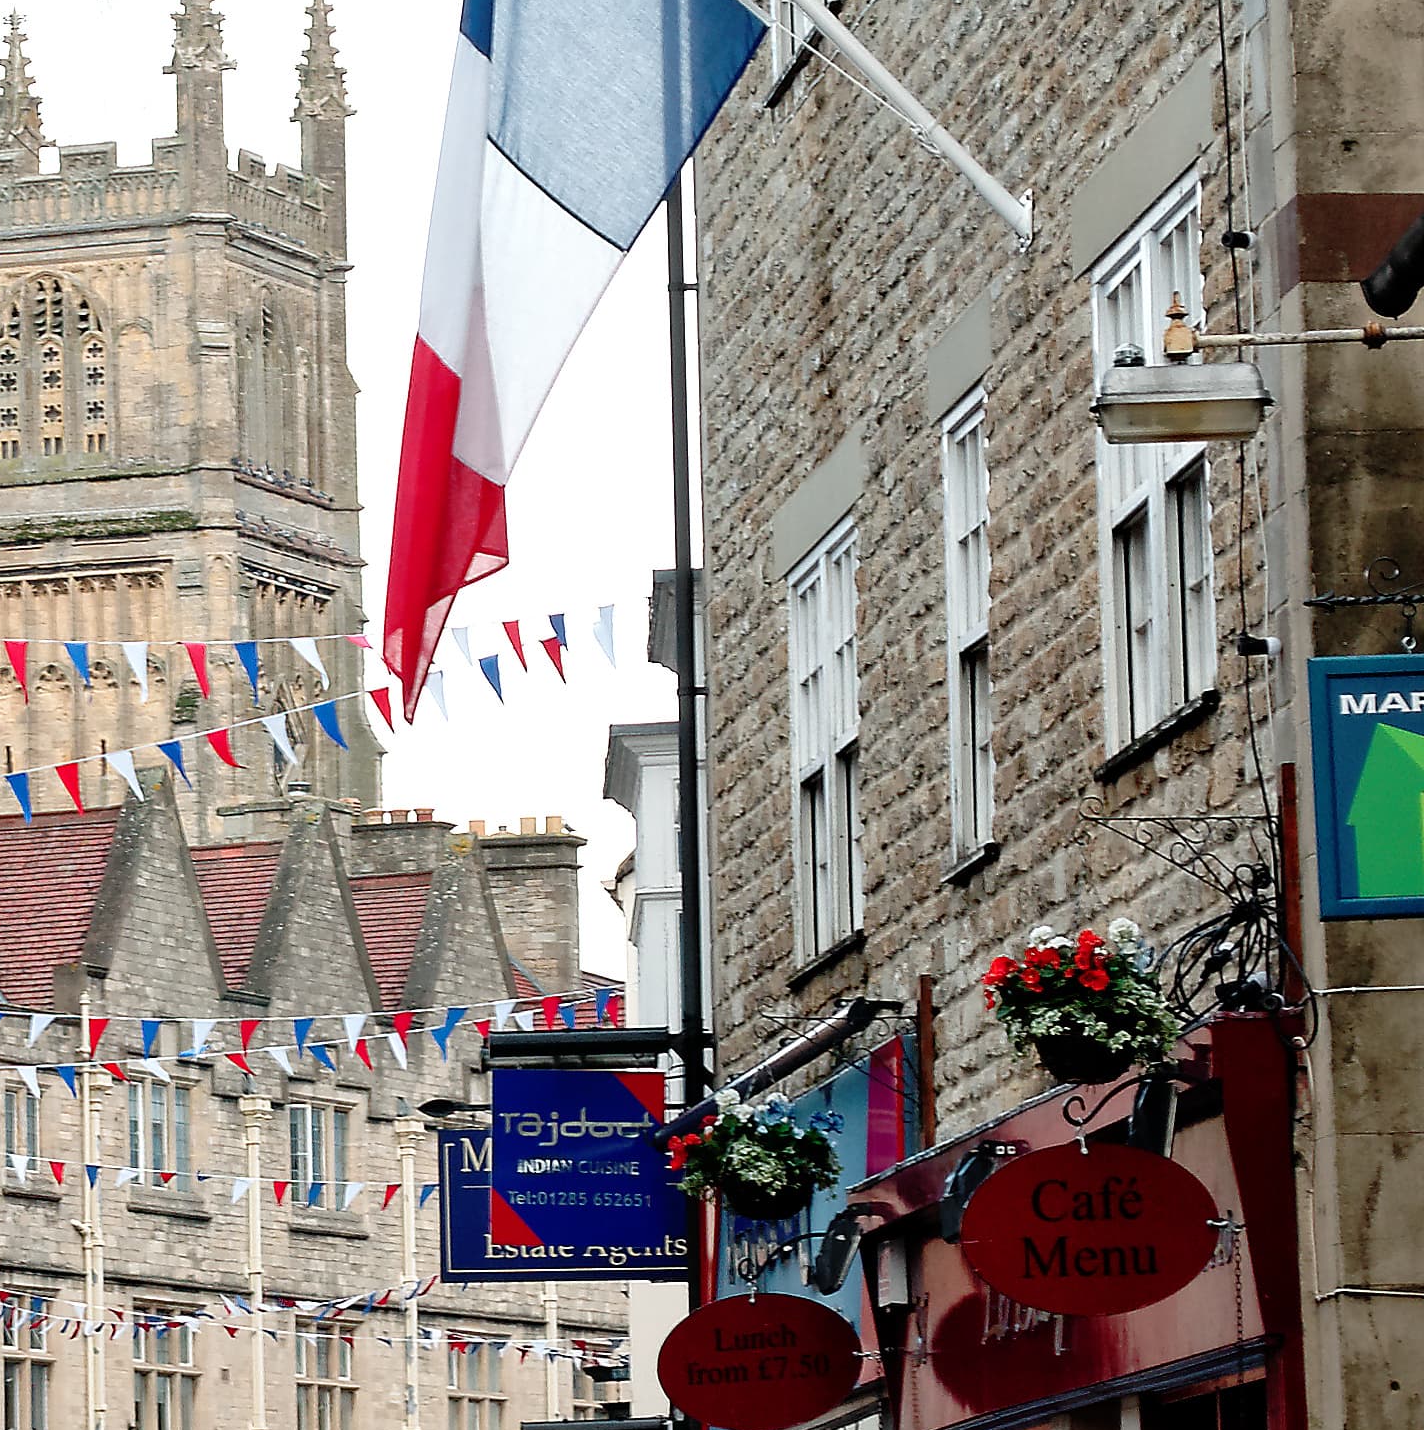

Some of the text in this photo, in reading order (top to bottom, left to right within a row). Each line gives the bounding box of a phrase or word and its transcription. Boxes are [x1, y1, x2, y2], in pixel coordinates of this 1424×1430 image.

[517, 1159, 641, 1176] INDIAN CUISINE
[593, 1192, 651, 1207] 652651
[1031, 1177, 1143, 1222] Café
[1021, 1235, 1158, 1279] Menu
[714, 1323, 797, 1352] Lunch
[688, 1354, 830, 1385] from £7.50
